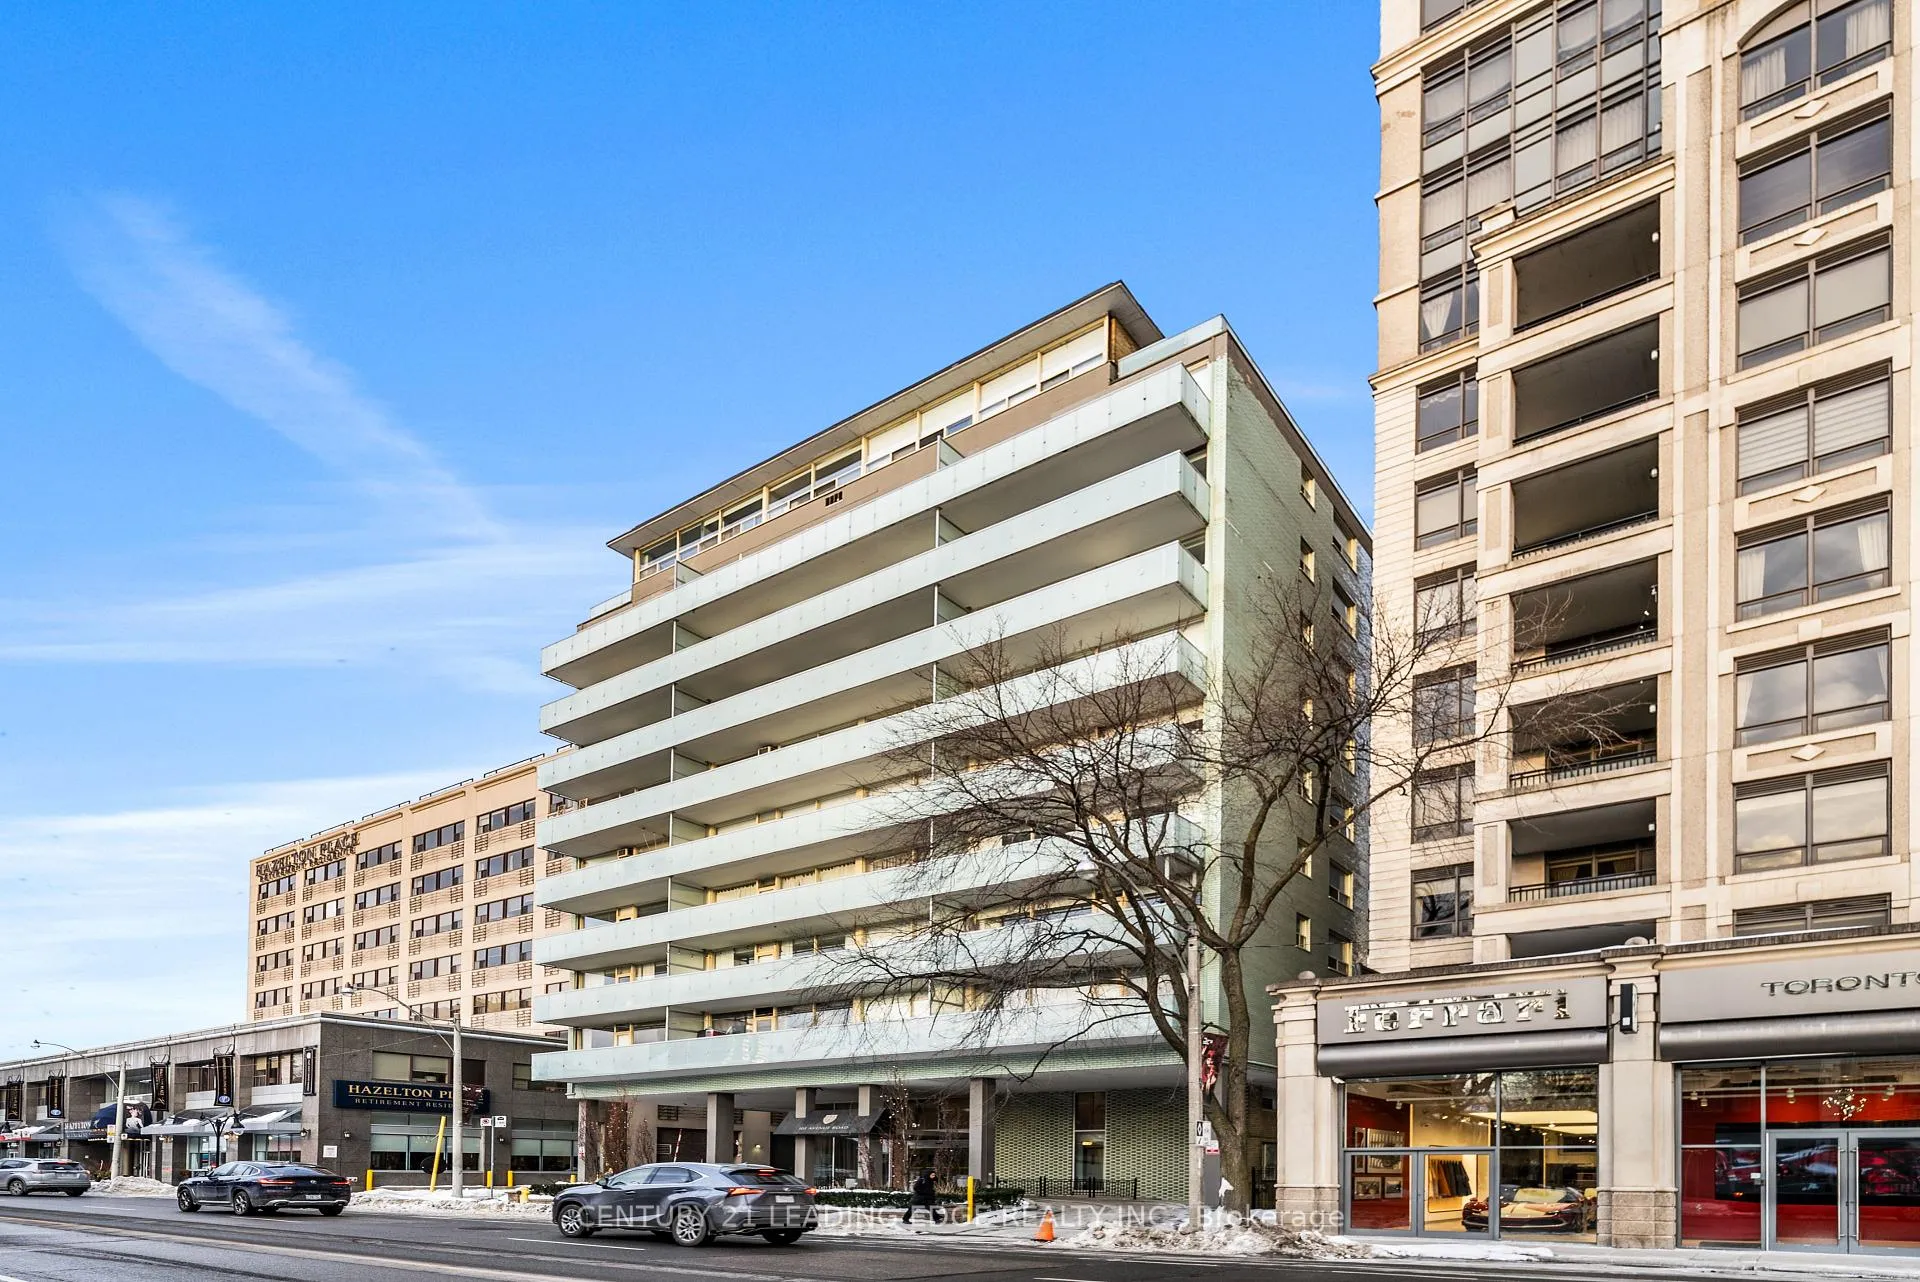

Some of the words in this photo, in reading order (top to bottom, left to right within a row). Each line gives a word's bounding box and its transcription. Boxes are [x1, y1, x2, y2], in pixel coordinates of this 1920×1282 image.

[256, 847, 315, 877] HAZELTON
[319, 832, 360, 856] PLACE
[1760, 971, 1920, 997] TORONT
[1343, 988, 1572, 1034] Ferrari
[347, 1084, 433, 1098] HAZELTON
[355, 1098, 421, 1107] RETIREMENT
